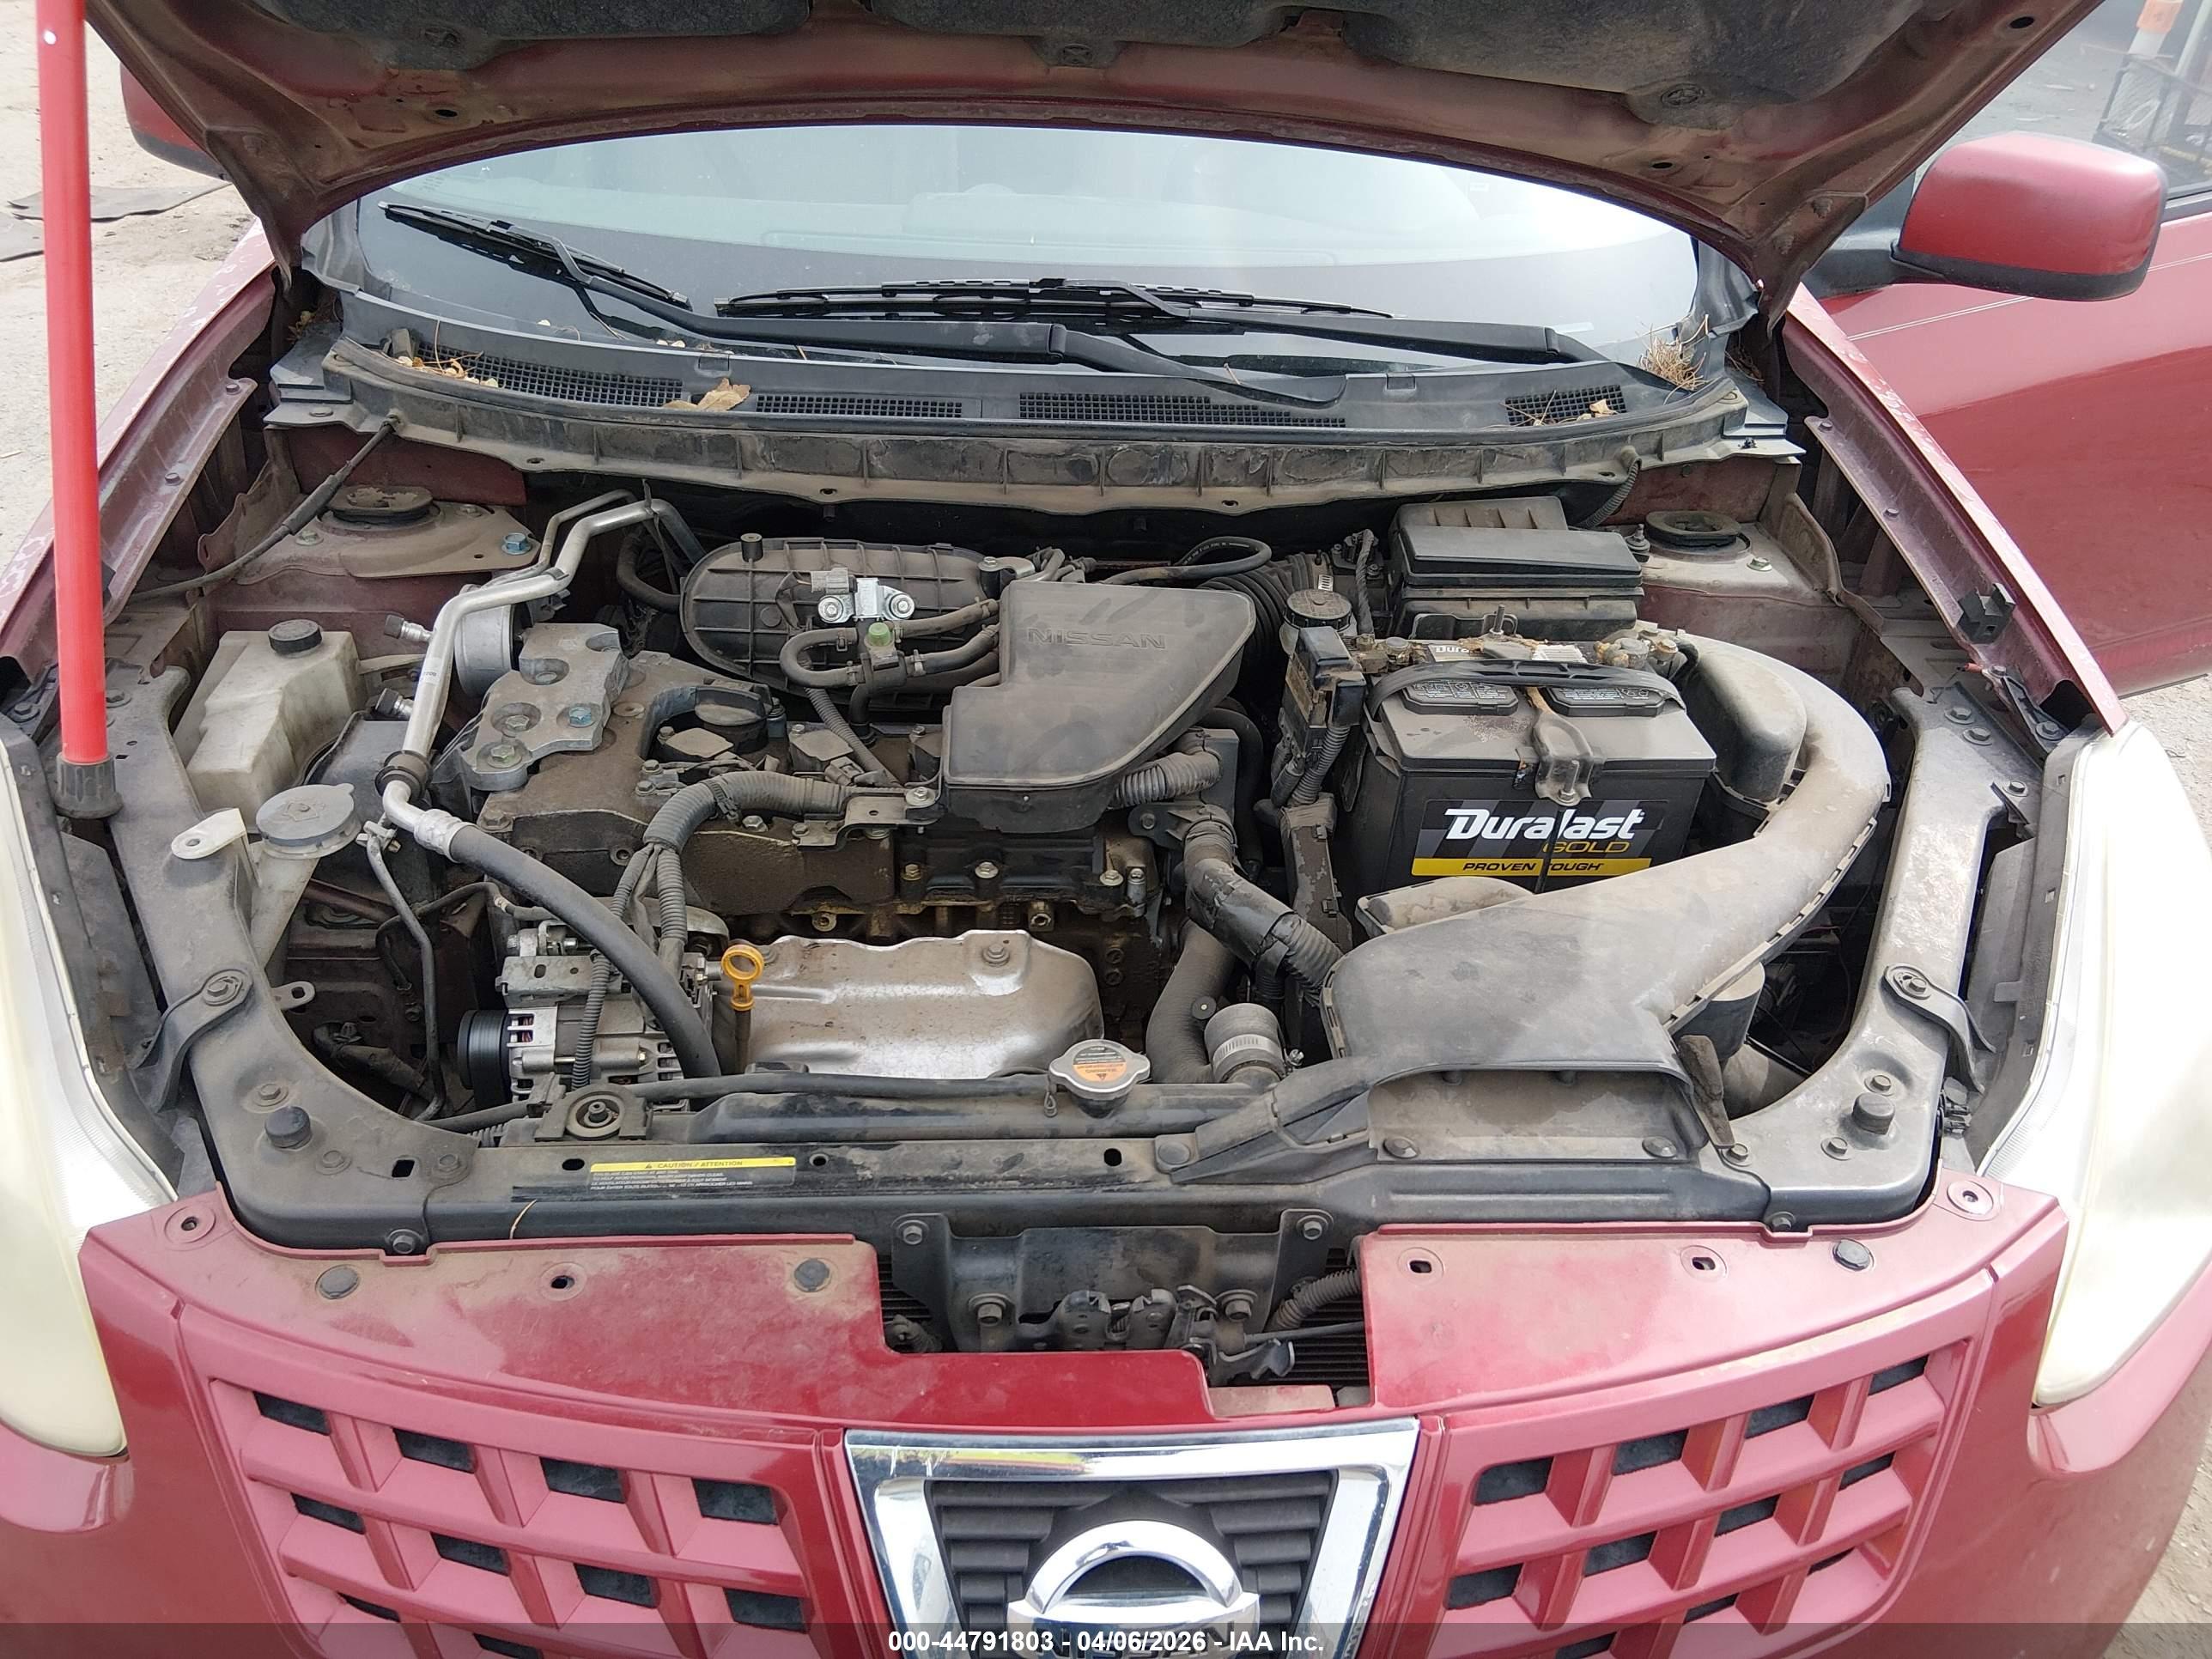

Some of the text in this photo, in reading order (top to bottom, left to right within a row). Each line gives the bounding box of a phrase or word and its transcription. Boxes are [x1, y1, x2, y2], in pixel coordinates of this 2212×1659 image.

[1029, 628, 1166, 649] NISSAN
[1444, 808, 1644, 840] Duralast
[1542, 841, 1630, 853] GOLD
[1462, 862, 1601, 872] PROVEN OUGH
